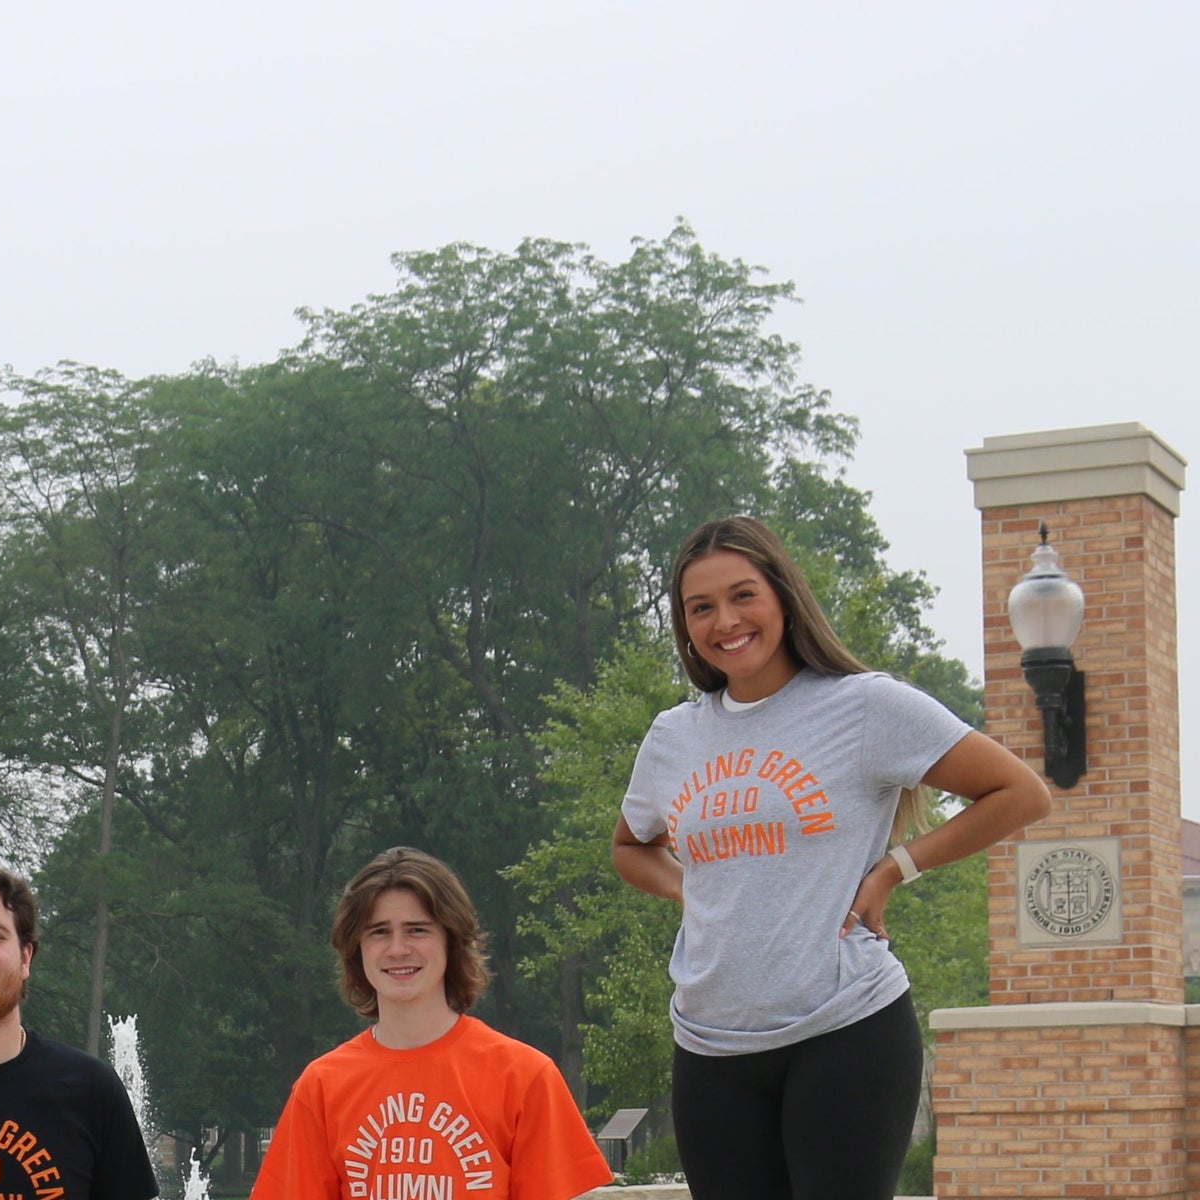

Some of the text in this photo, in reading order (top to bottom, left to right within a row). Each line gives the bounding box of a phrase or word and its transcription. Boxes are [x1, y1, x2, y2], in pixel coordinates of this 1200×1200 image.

[701, 786, 760, 820] 1910
[757, 749, 836, 836] GREEN
[686, 822, 785, 864] ALUMNI
[1062, 851, 1092, 862] STATE
[1058, 925, 1081, 934] 1910
[344, 1092, 493, 1198] BOWLING GREEN
[379, 1136, 433, 1165] 1910
